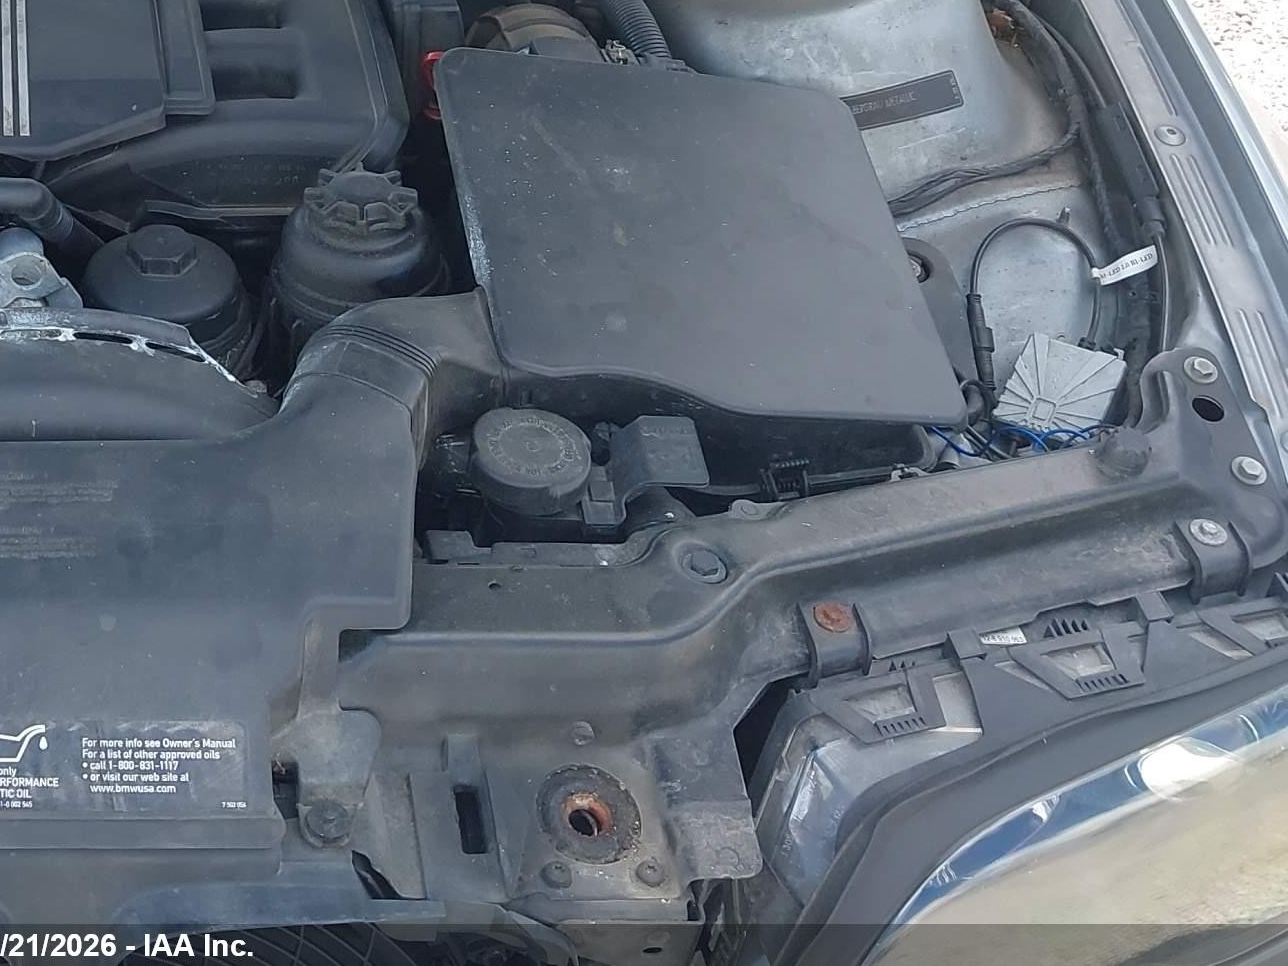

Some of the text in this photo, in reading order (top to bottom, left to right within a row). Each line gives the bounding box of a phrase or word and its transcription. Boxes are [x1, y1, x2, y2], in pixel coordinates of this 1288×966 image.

[82, 738, 236, 748] For more info see Owner's Manual
[82, 749, 221, 762] For a list of other approved oils
[89, 761, 179, 770] call 1-800-831-1117
[89, 772, 190, 782] or visit our web site at
[16, 788, 32, 798] OIL
[89, 784, 177, 794] www.bmwusa.com
